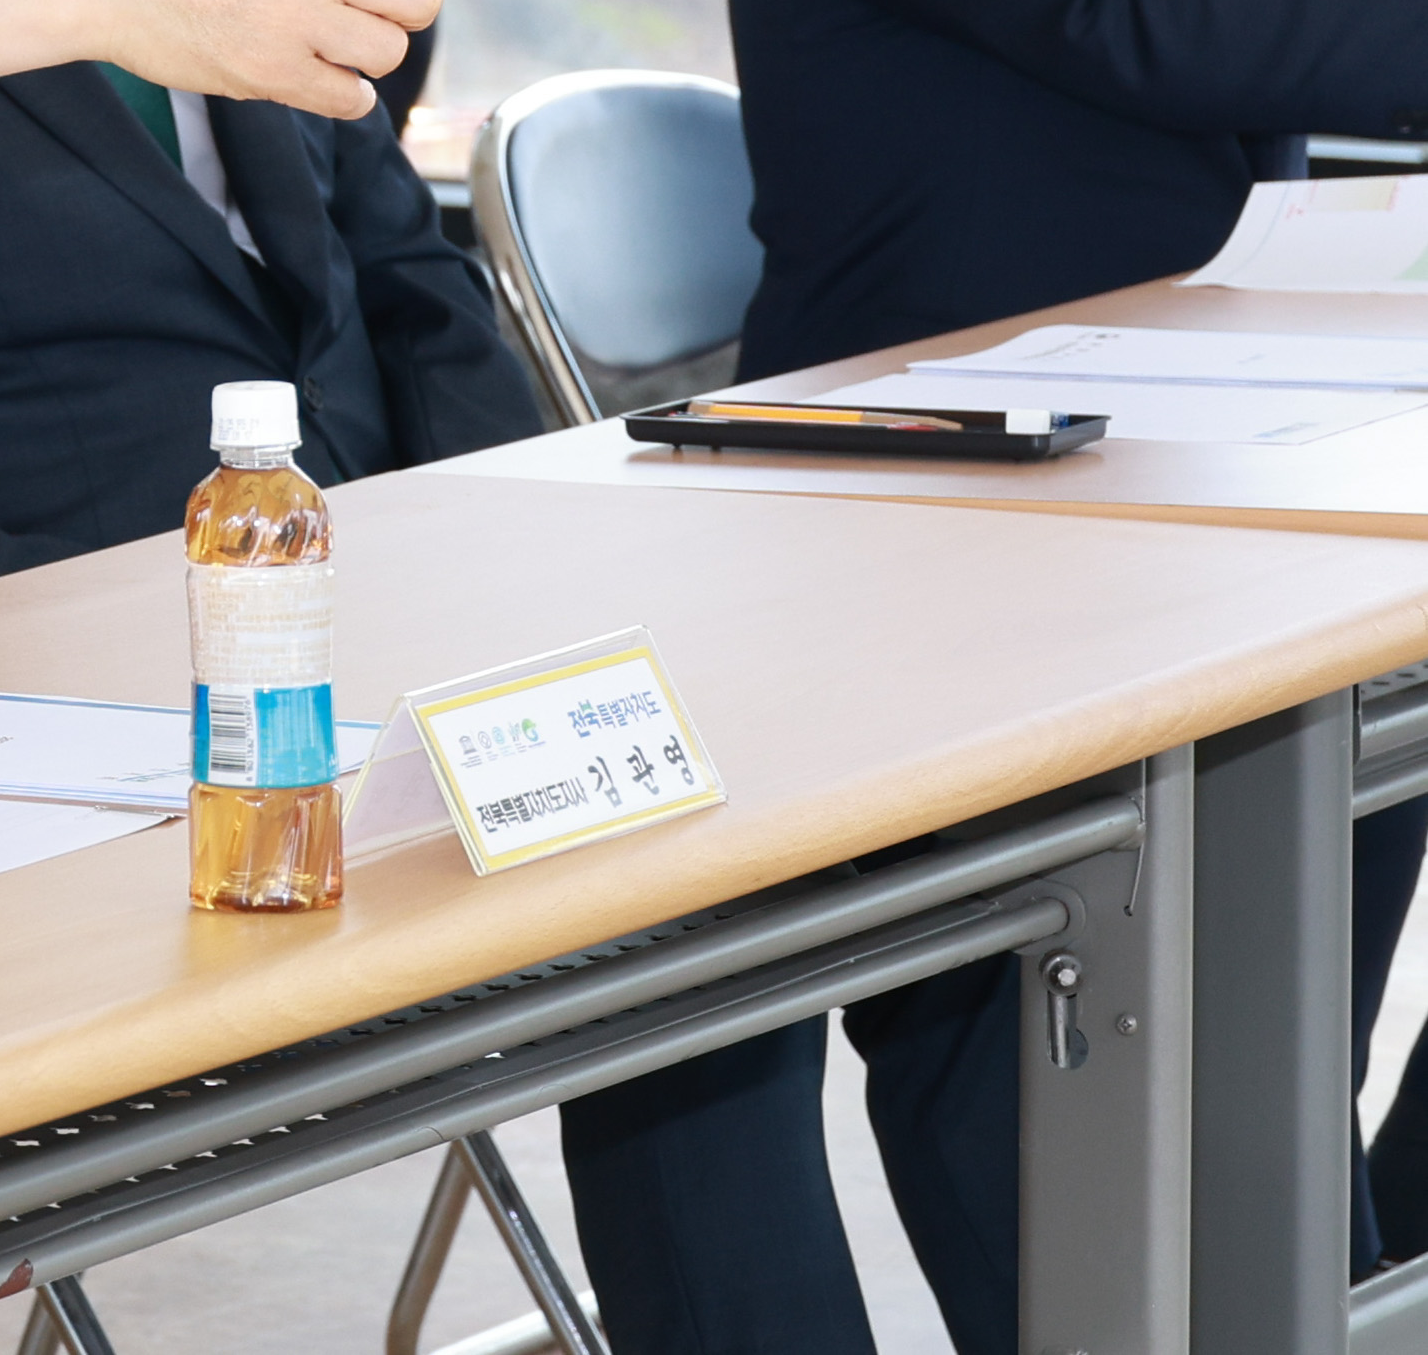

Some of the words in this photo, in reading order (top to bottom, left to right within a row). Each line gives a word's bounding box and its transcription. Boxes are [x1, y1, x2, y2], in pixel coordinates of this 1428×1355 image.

[568, 691, 661, 738] 전북특별자치도
[476, 777, 589, 833] 전북특별자치도지사
[587, 755, 622, 807] 김
